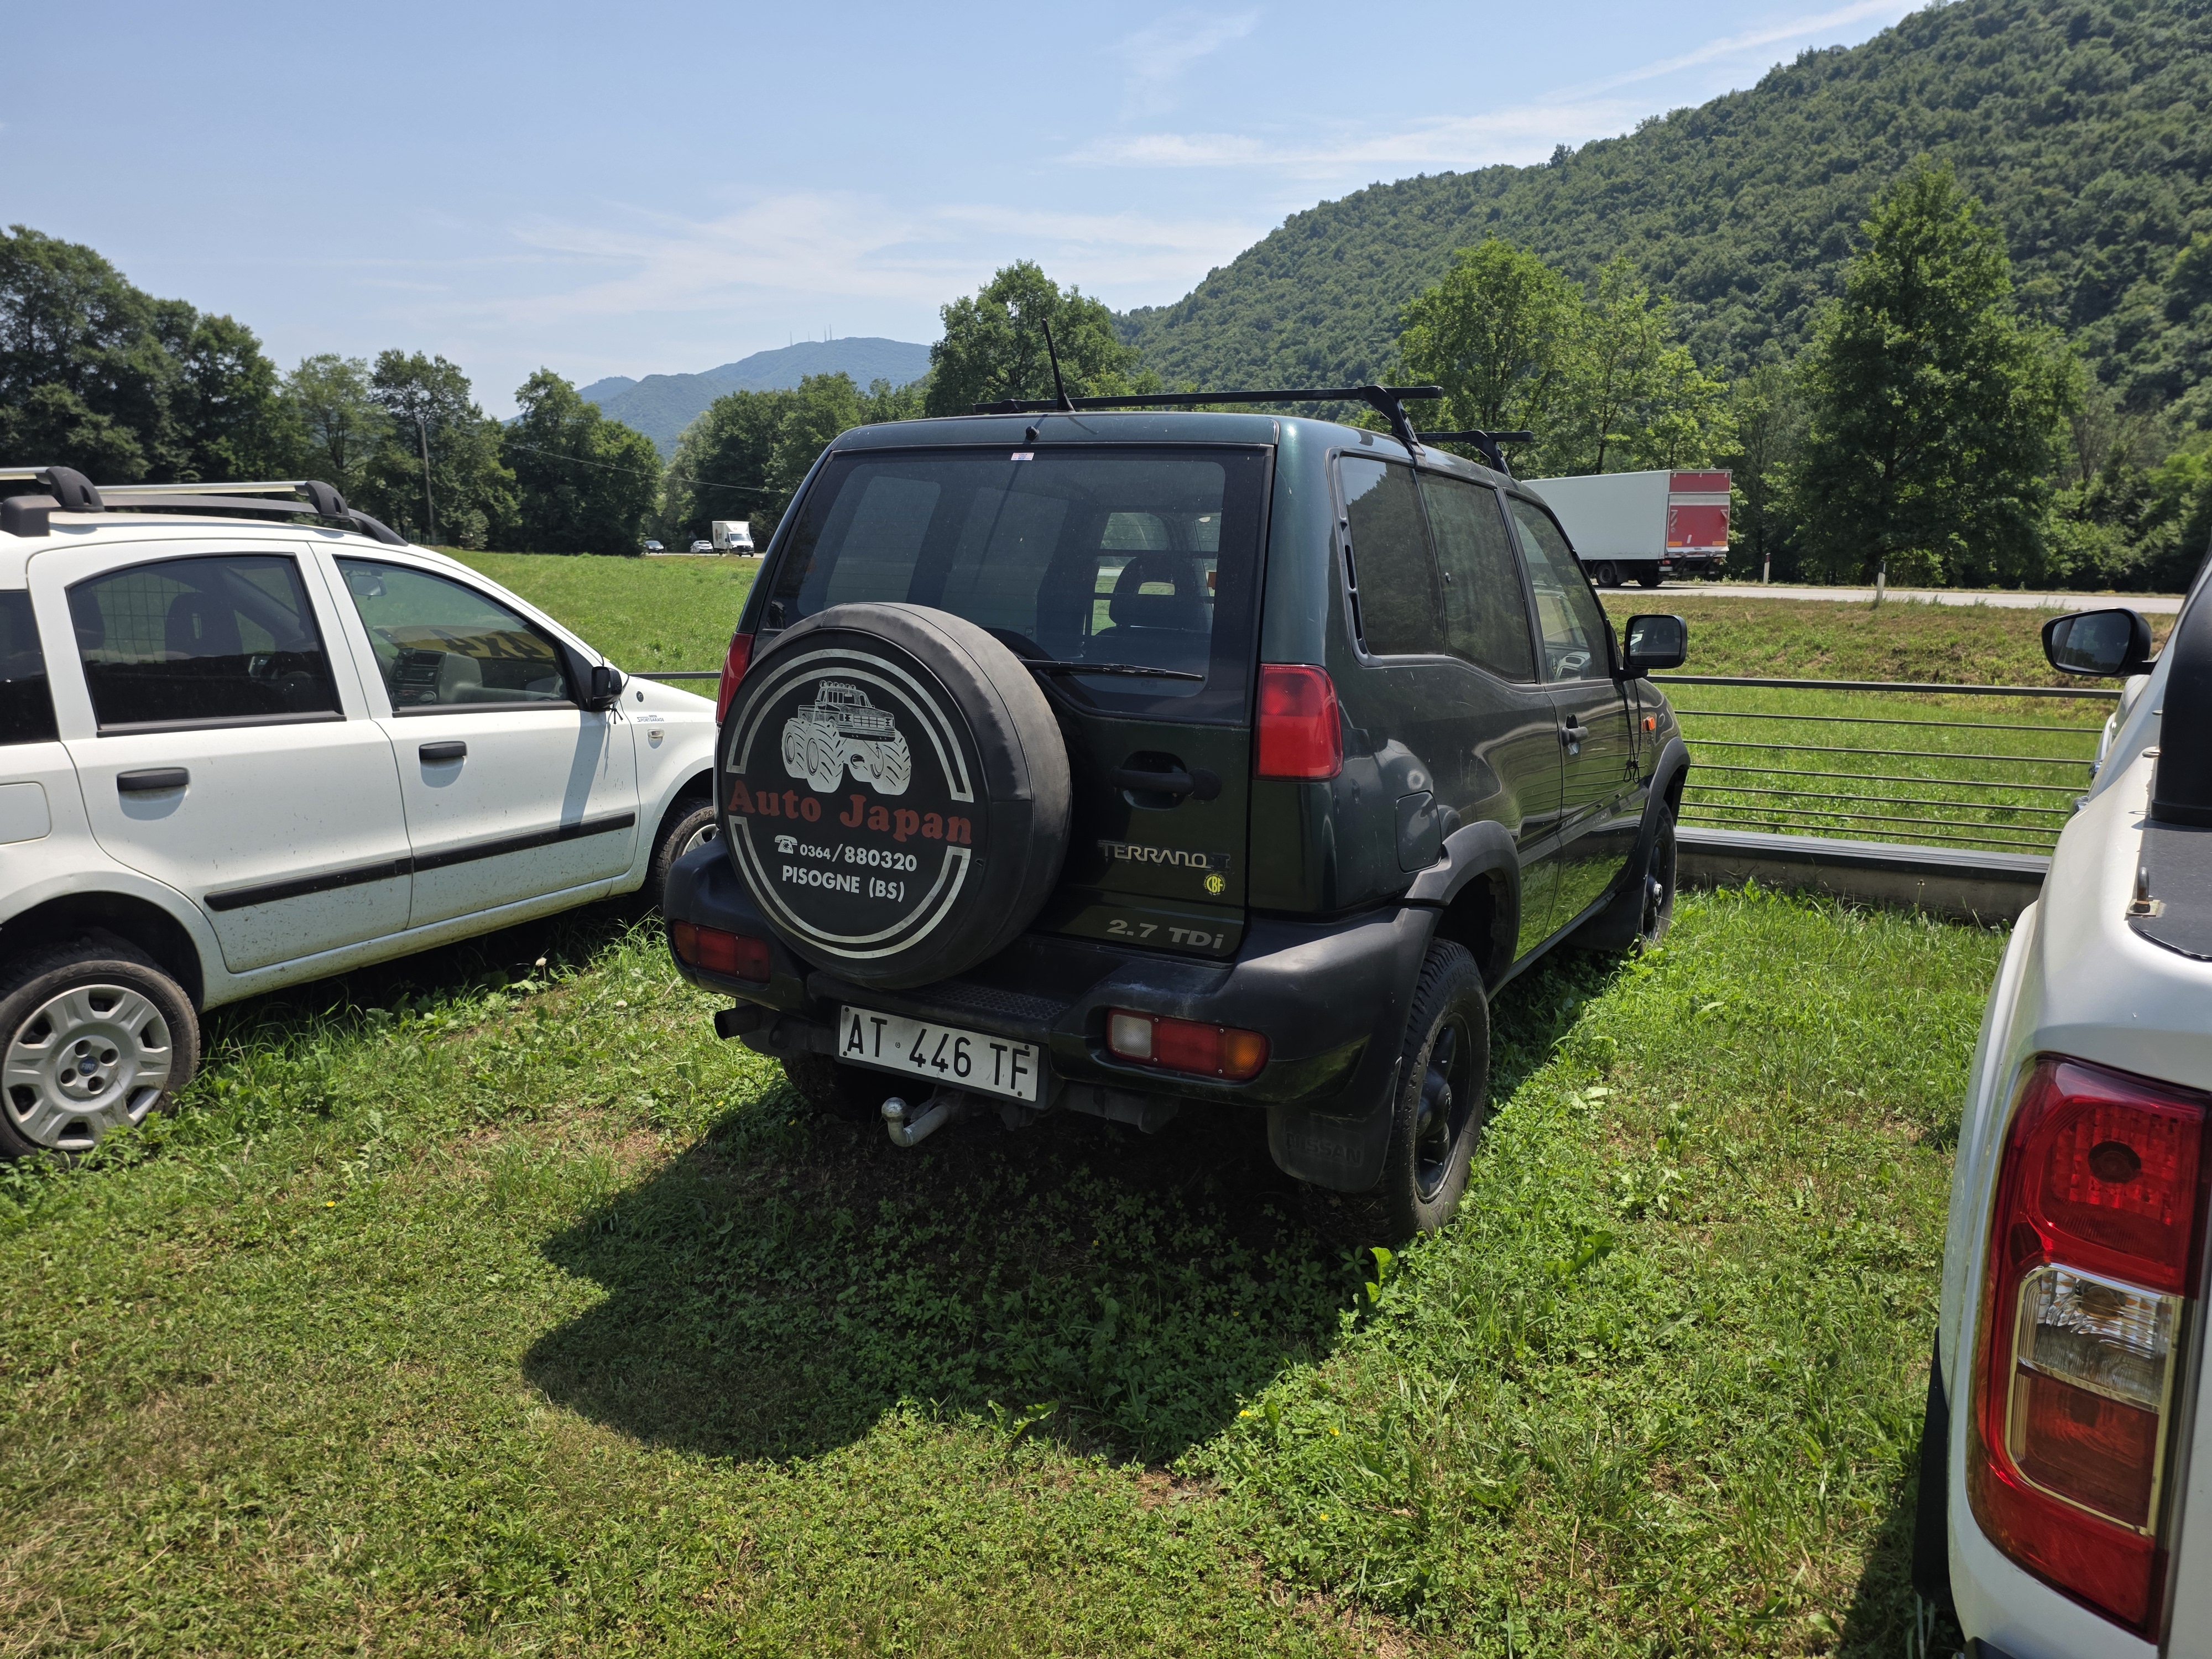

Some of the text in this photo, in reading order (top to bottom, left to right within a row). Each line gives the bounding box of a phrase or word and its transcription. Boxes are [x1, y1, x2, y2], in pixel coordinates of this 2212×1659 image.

[728, 780, 972, 844] Auto Japan
[800, 844, 917, 872] 0364/880320
[1098, 841, 1212, 869] TERRANO
[782, 865, 904, 902] PISOGNE (BS)
[1206, 875, 1223, 893] CBF
[1107, 919, 1224, 950] 2.7 TDi
[81, 1062, 96, 1071] FIAT
[847, 1014, 1031, 1090] AT 446 TF
[1286, 1132, 1361, 1164] NISSAN
